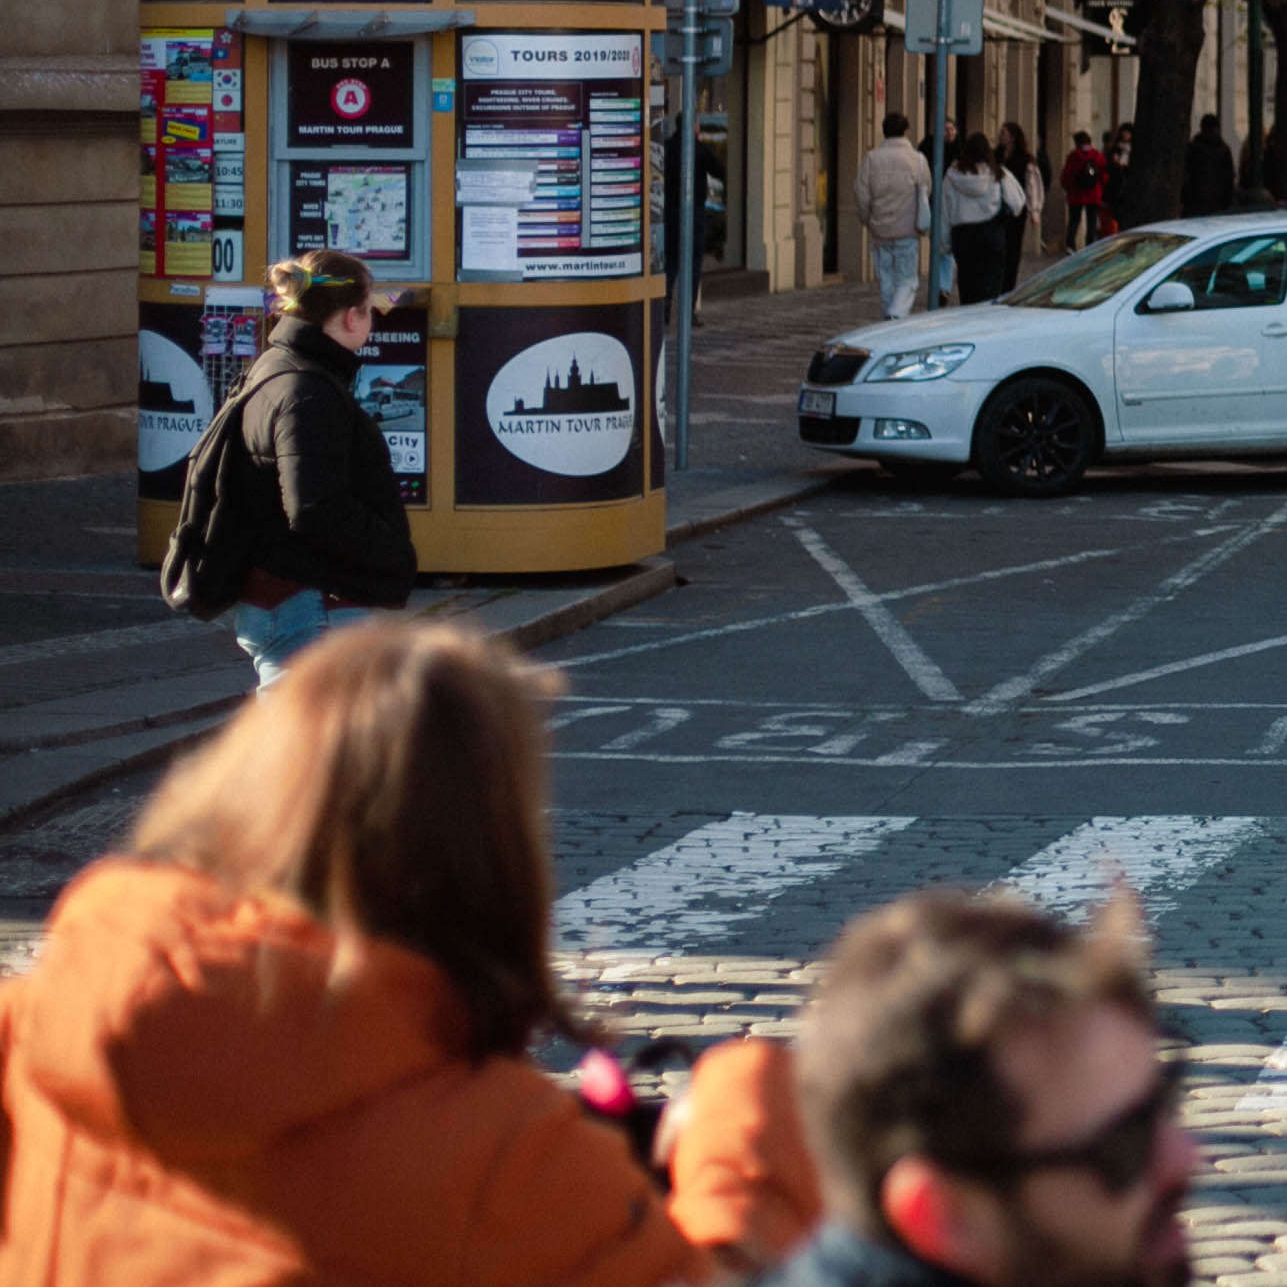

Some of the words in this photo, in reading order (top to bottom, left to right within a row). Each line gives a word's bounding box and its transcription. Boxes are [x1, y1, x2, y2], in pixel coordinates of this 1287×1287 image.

[510, 49, 568, 62] TOURS
[311, 57, 339, 69] BUS
[341, 57, 378, 69] STOP
[380, 58, 391, 69] A
[343, 90, 359, 105] A
[298, 125, 335, 134] MARTIN
[337, 125, 363, 134] TOUR
[365, 125, 404, 134] PRAGUE
[215, 166, 243, 177] 10:45
[367, 331, 421, 343] TSEEING
[157, 416, 204, 433] PRAGUE
[497, 418, 562, 434] MARTIN
[565, 417, 602, 433] TOUR
[388, 434, 419, 448] City
